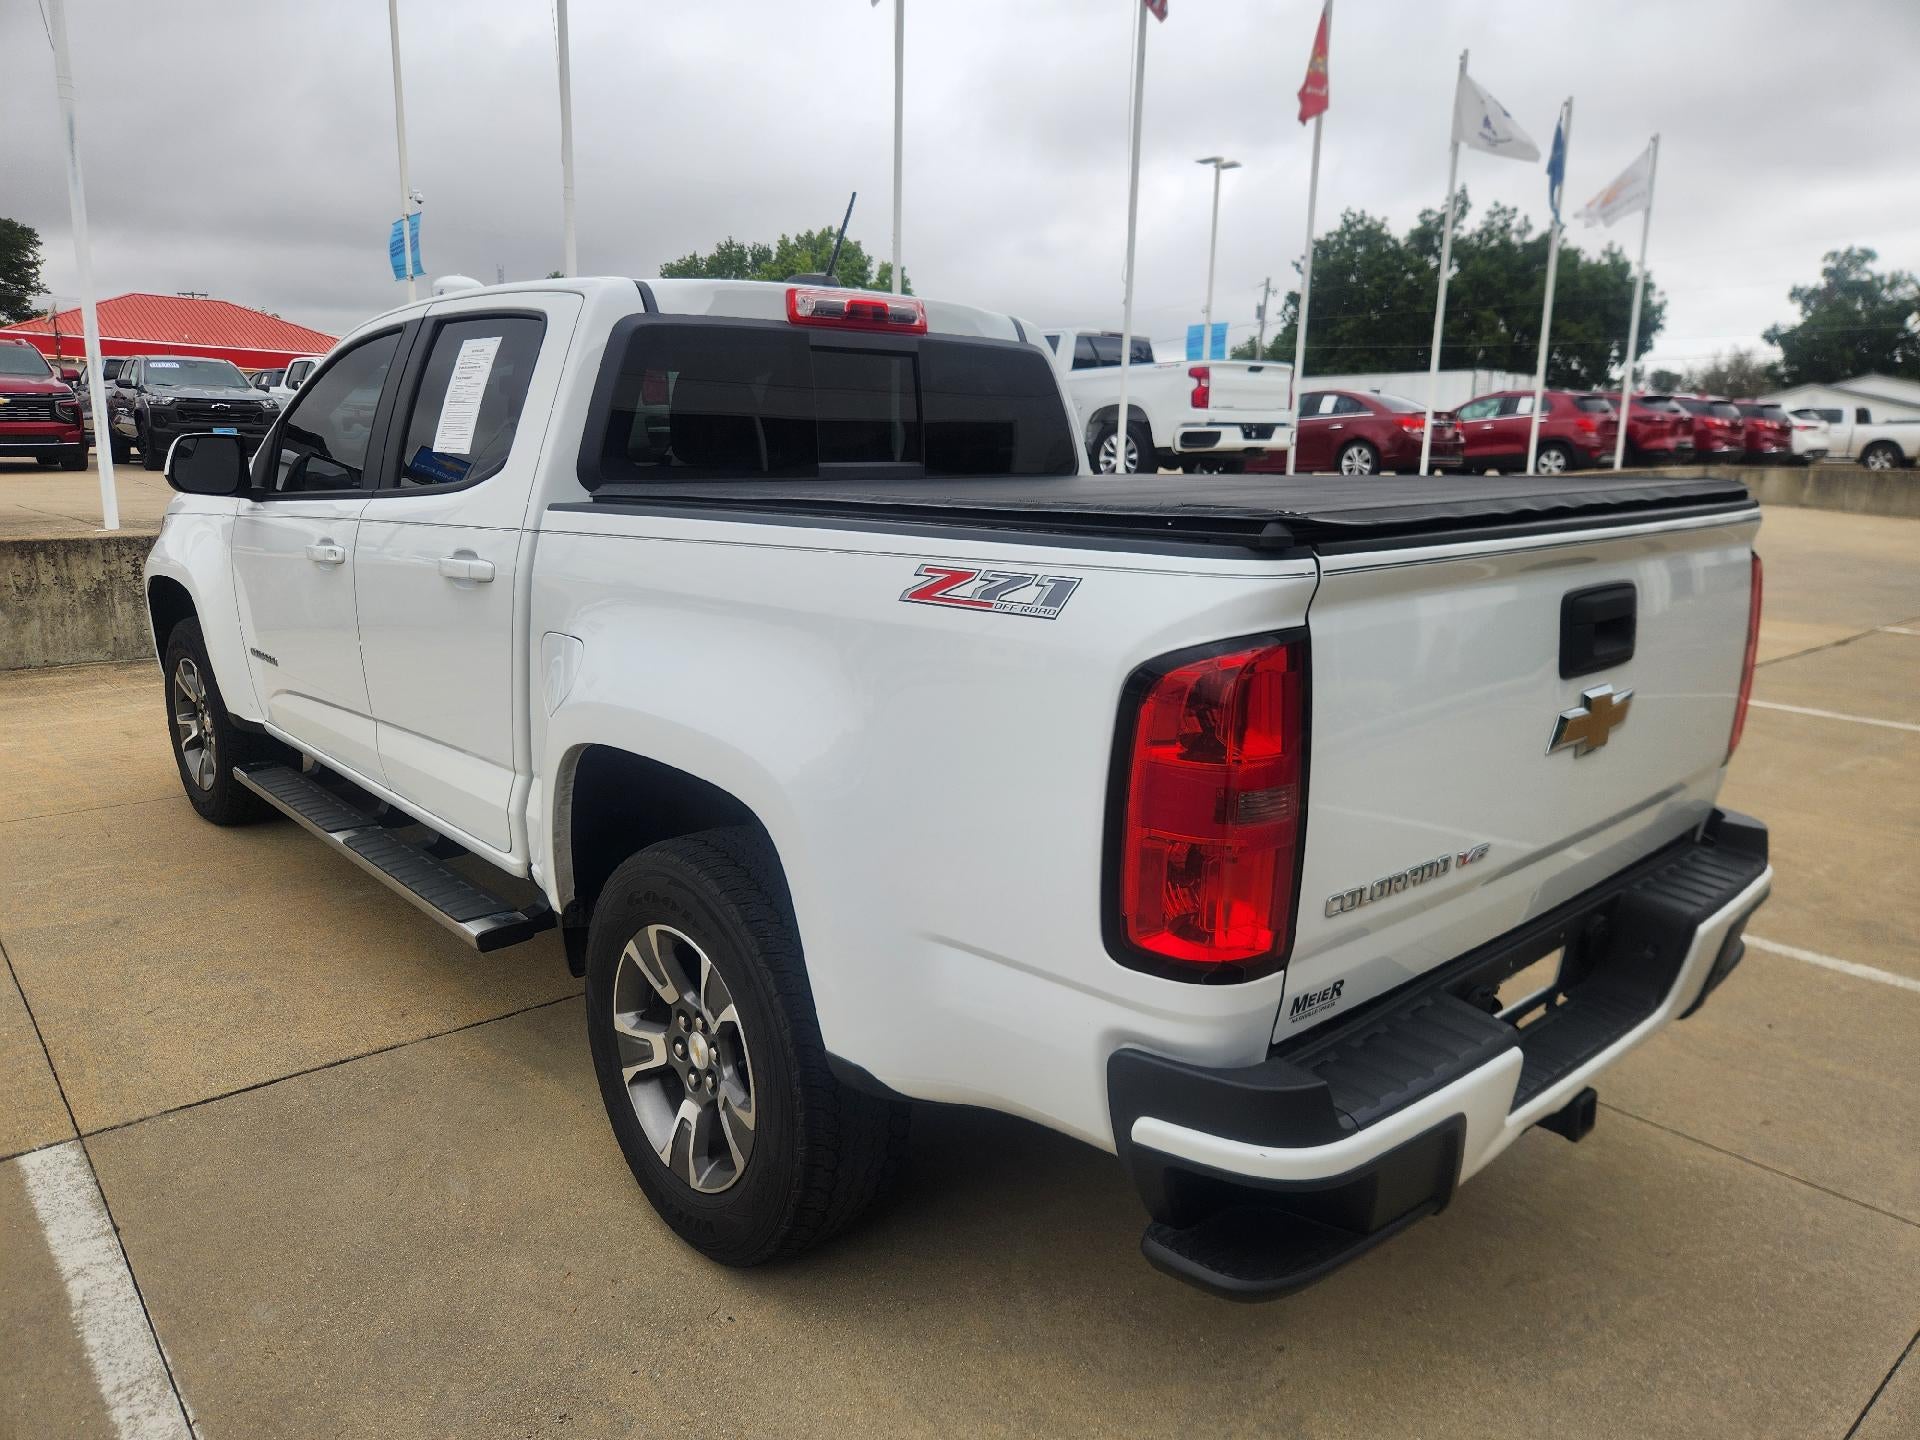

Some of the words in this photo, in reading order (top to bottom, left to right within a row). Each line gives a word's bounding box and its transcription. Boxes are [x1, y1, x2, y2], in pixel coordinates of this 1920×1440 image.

[899, 564, 1083, 612] Z71
[995, 602, 1018, 611] OFF
[1020, 605, 1057, 616] ROAD
[1325, 854, 1452, 918] COLORADO
[1290, 979, 1344, 1016] MEIER
